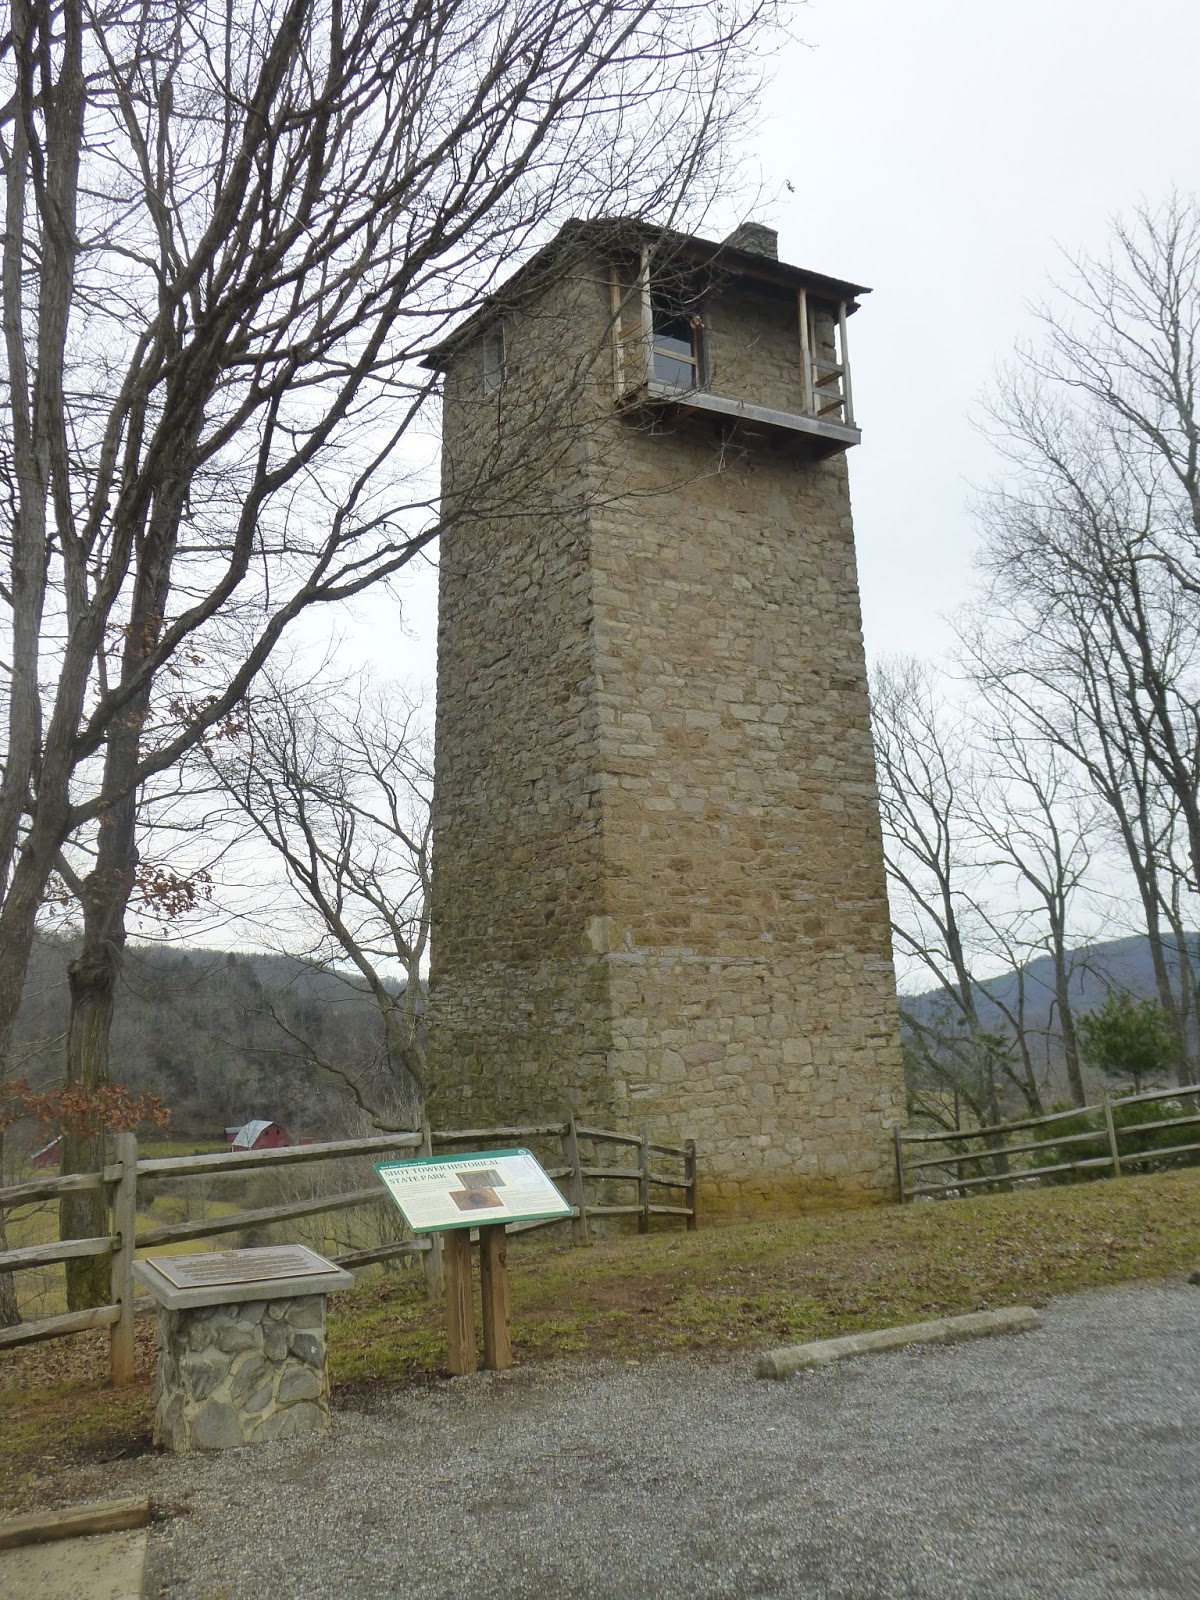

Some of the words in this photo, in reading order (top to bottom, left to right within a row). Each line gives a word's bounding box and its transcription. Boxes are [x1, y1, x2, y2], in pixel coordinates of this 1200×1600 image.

[384, 1169, 409, 1177] SHOT
[411, 1165, 446, 1174] TOWER
[448, 1159, 501, 1170] HISTORICAL
[389, 1175, 419, 1185] STATE
[421, 1172, 447, 1181] PARK
